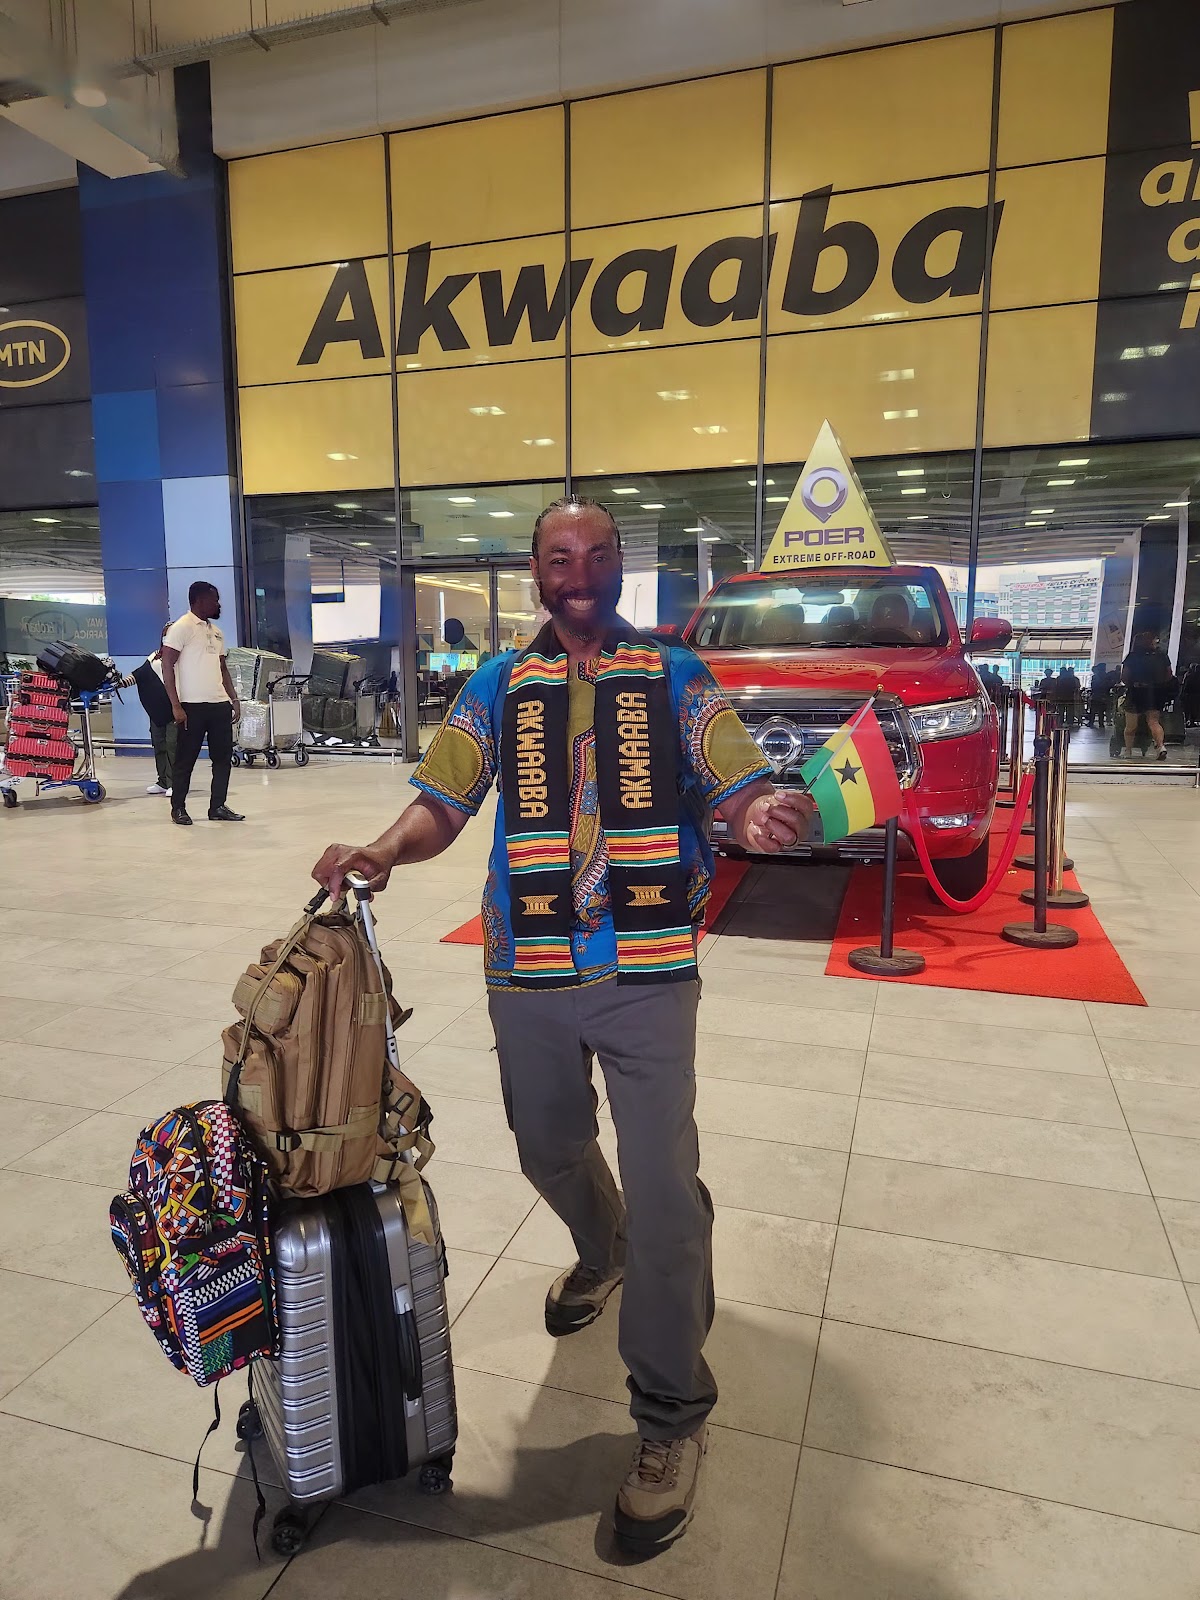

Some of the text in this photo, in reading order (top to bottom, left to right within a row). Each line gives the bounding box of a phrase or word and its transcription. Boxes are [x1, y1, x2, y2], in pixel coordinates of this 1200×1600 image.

[296, 183, 1005, 366] Akwaaba
[773, 550, 876, 564] EXTREME OFF-ROAD
[784, 526, 865, 548] POER
[516, 699, 549, 818] AKWAABA
[615, 691, 653, 809] AKWAABA
